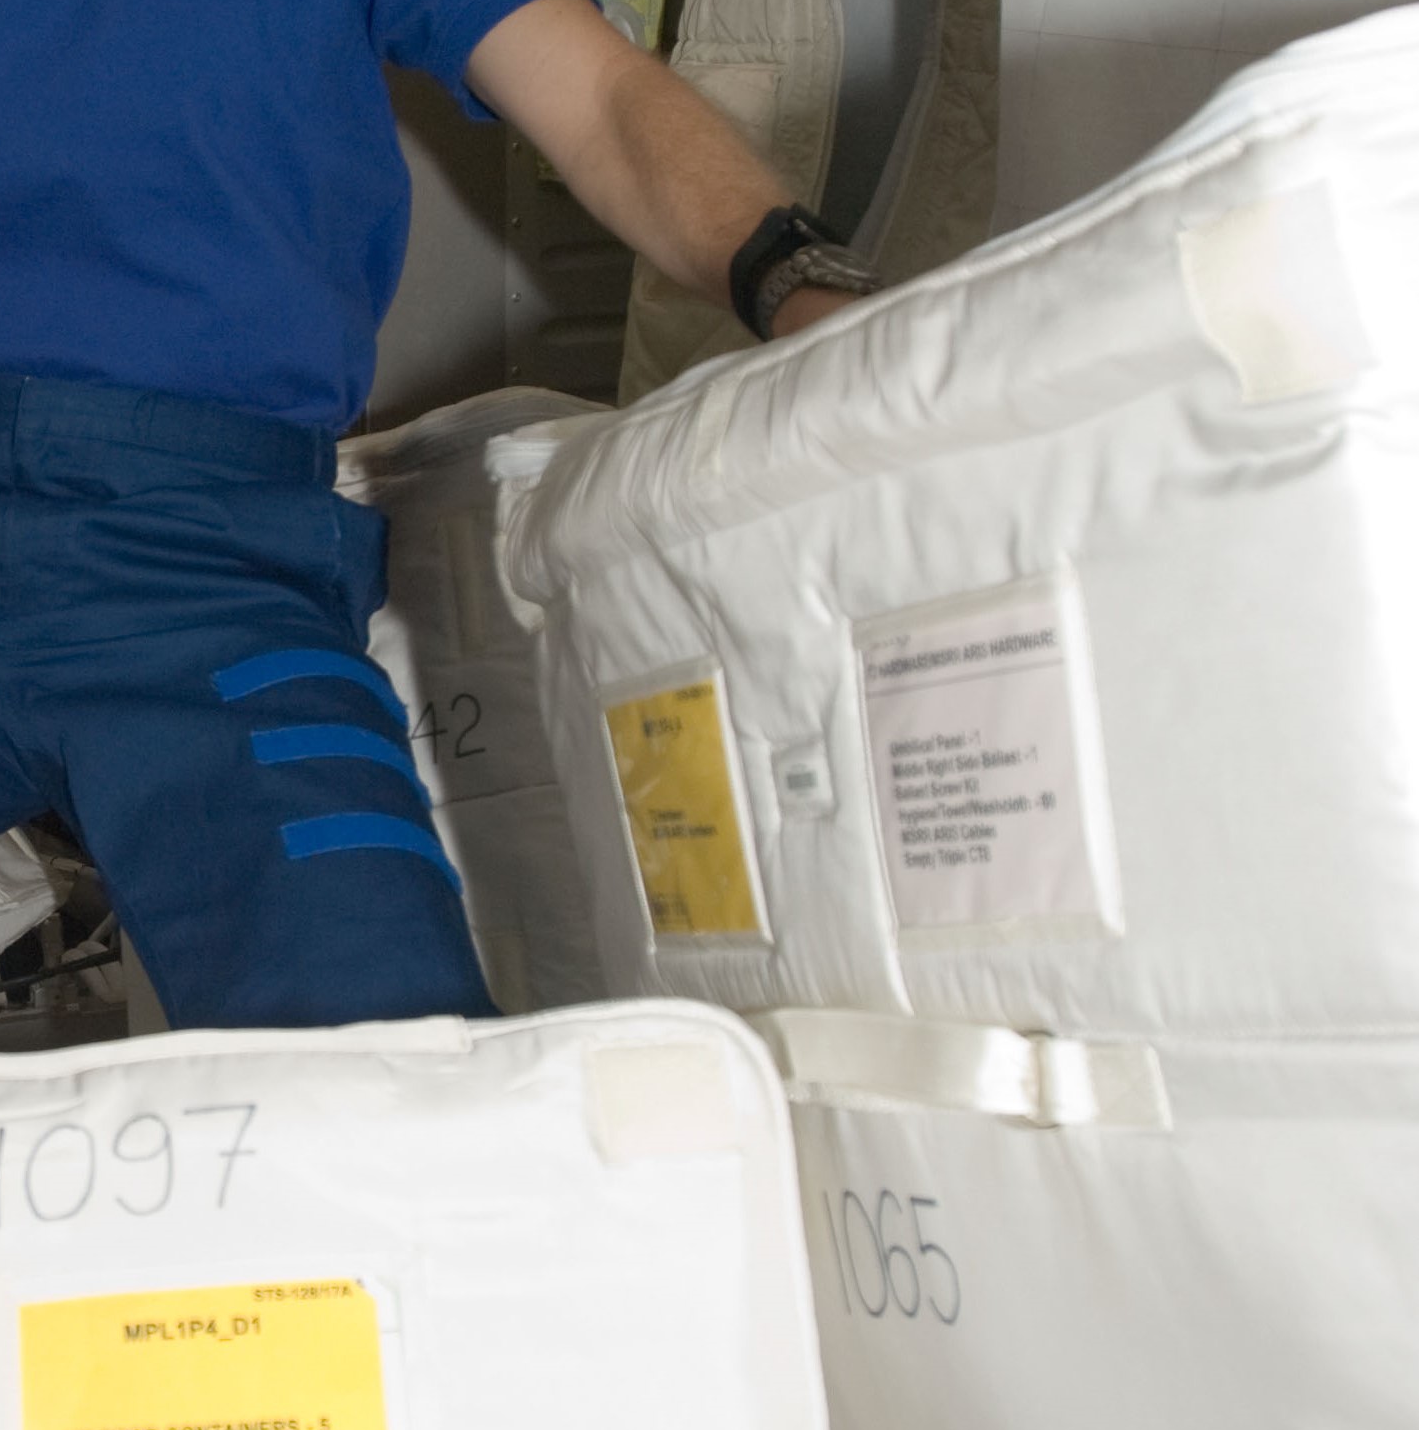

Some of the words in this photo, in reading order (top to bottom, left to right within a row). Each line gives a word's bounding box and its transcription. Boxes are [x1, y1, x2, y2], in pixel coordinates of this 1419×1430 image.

[990, 627, 1058, 658] HARDWARE
[411, 693, 486, 764] 42
[823, 1188, 962, 1326] 1065
[124, 1316, 262, 1343] MPL1P4_D1
